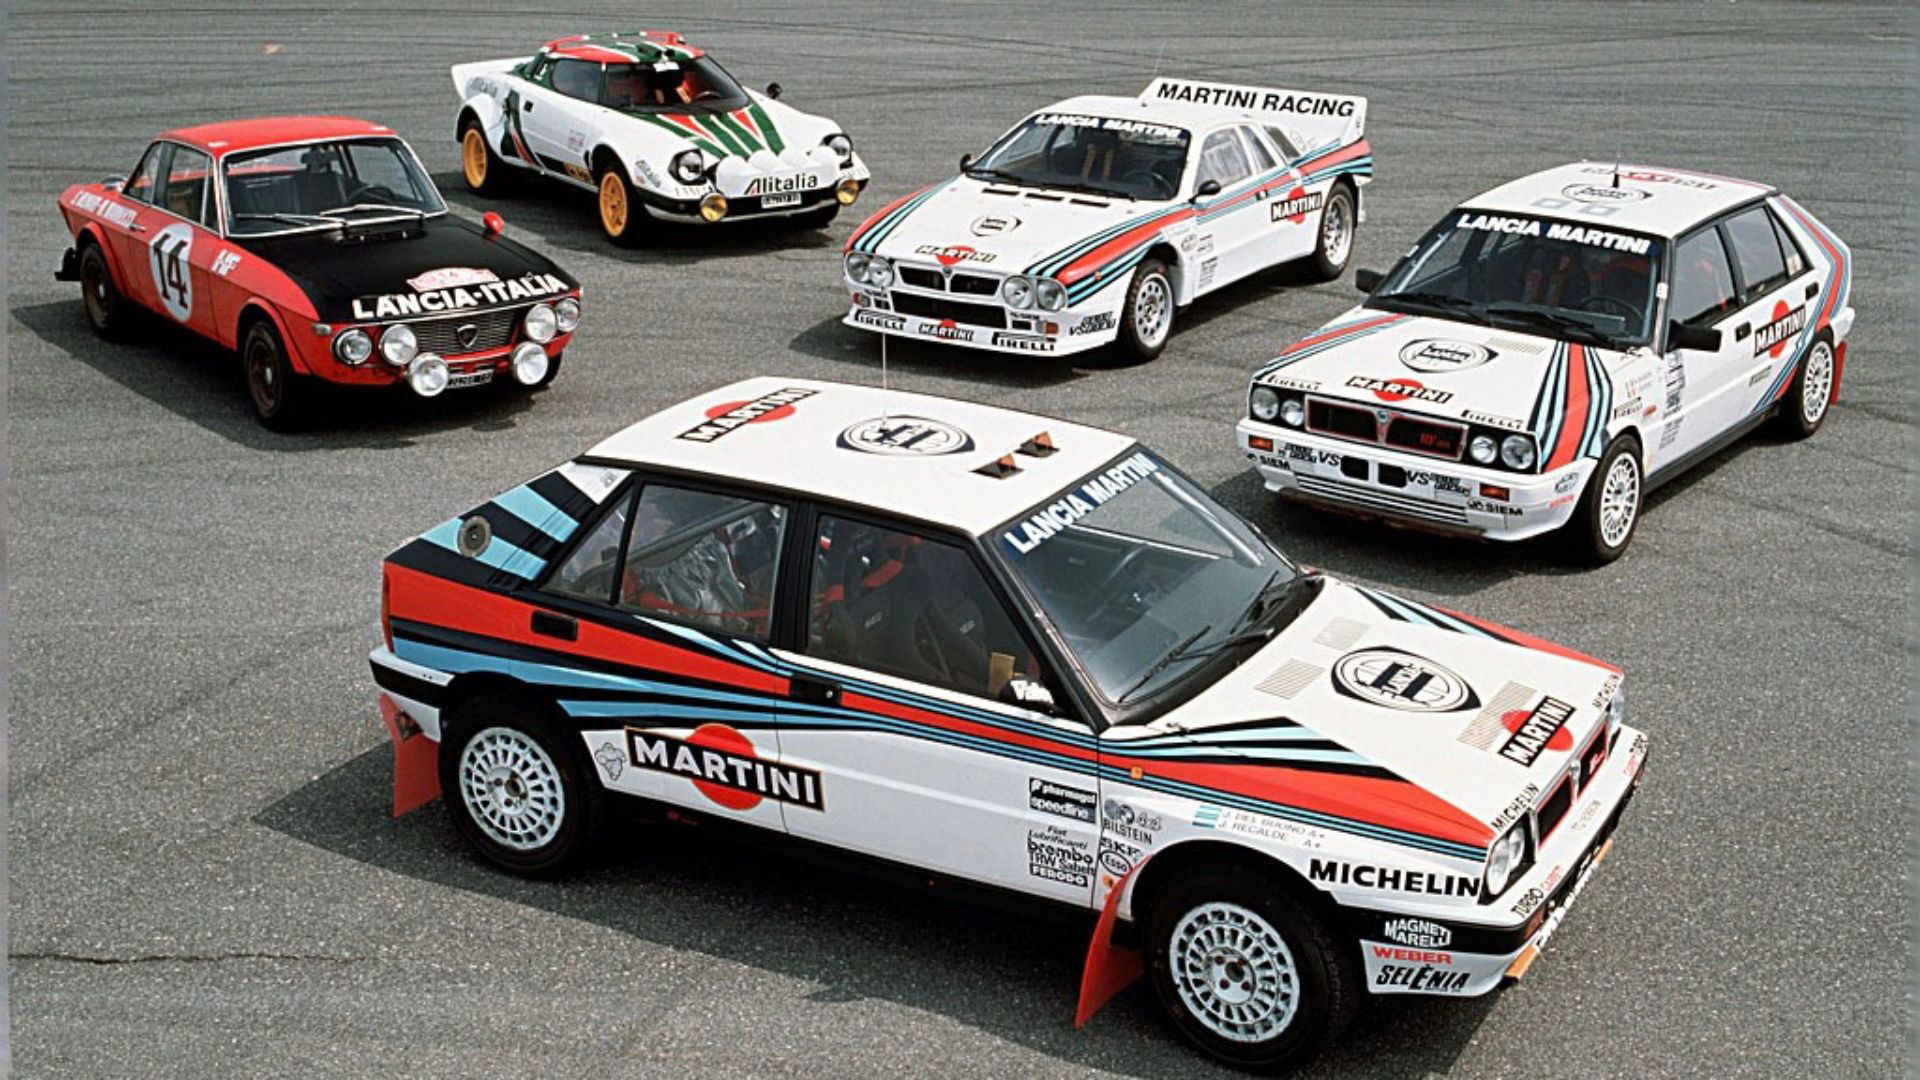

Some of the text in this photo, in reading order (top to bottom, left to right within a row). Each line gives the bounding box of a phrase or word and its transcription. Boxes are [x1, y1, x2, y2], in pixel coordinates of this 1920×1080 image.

[1157, 83, 1355, 117] MARTINI RACING
[1035, 114, 1182, 138] LANCIA MARTINI
[743, 172, 818, 195] Alitalia
[1273, 194, 1321, 220] MARTINI
[1457, 214, 1651, 255] LANCIA MARTINI
[153, 233, 188, 310] 14
[352, 273, 569, 319] LANCIA-ITALIA
[919, 323, 974, 341] MARTINI
[1755, 308, 1805, 353] MARTINI
[1347, 376, 1454, 403] MARTINI
[682, 388, 817, 441] MARTINI
[1004, 452, 1158, 554] LANCIA MARTINI
[1502, 697, 1575, 765] MARTINI
[633, 735, 816, 804] MARTINI
[1491, 782, 1540, 832] MICHELIN
[1103, 818, 1152, 845] BILSTEIN
[1028, 838, 1094, 864] brembo
[1032, 866, 1085, 885] FERODO
[1309, 859, 1480, 896] MICHELIN
[1373, 945, 1453, 964] WEBER
